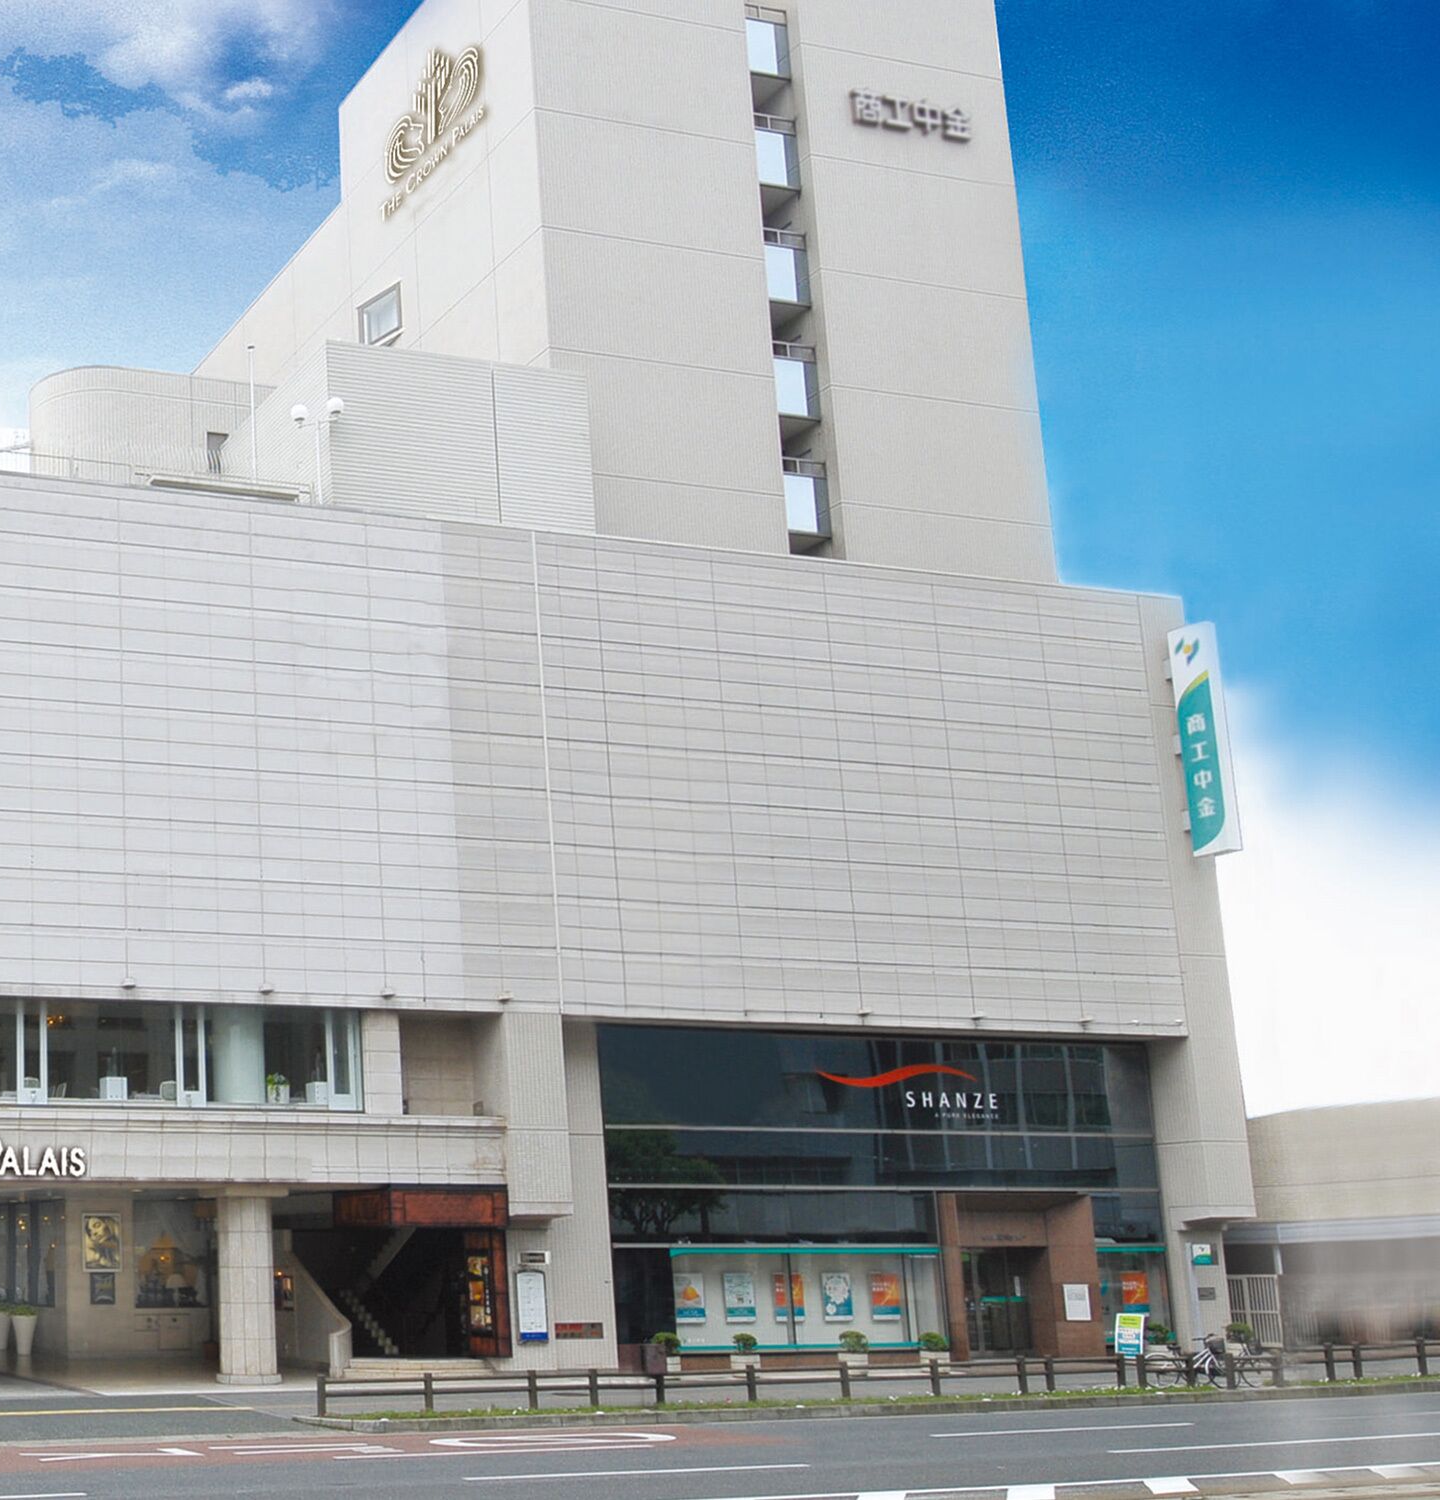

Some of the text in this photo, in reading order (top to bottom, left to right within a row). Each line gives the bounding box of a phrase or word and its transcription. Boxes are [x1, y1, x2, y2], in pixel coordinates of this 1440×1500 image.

[850, 88, 971, 143] 商工中金
[378, 105, 486, 222] THE CROWN PALAIS
[1186, 712, 1216, 820] 商工中金
[905, 1091, 998, 1109] SHANZE
